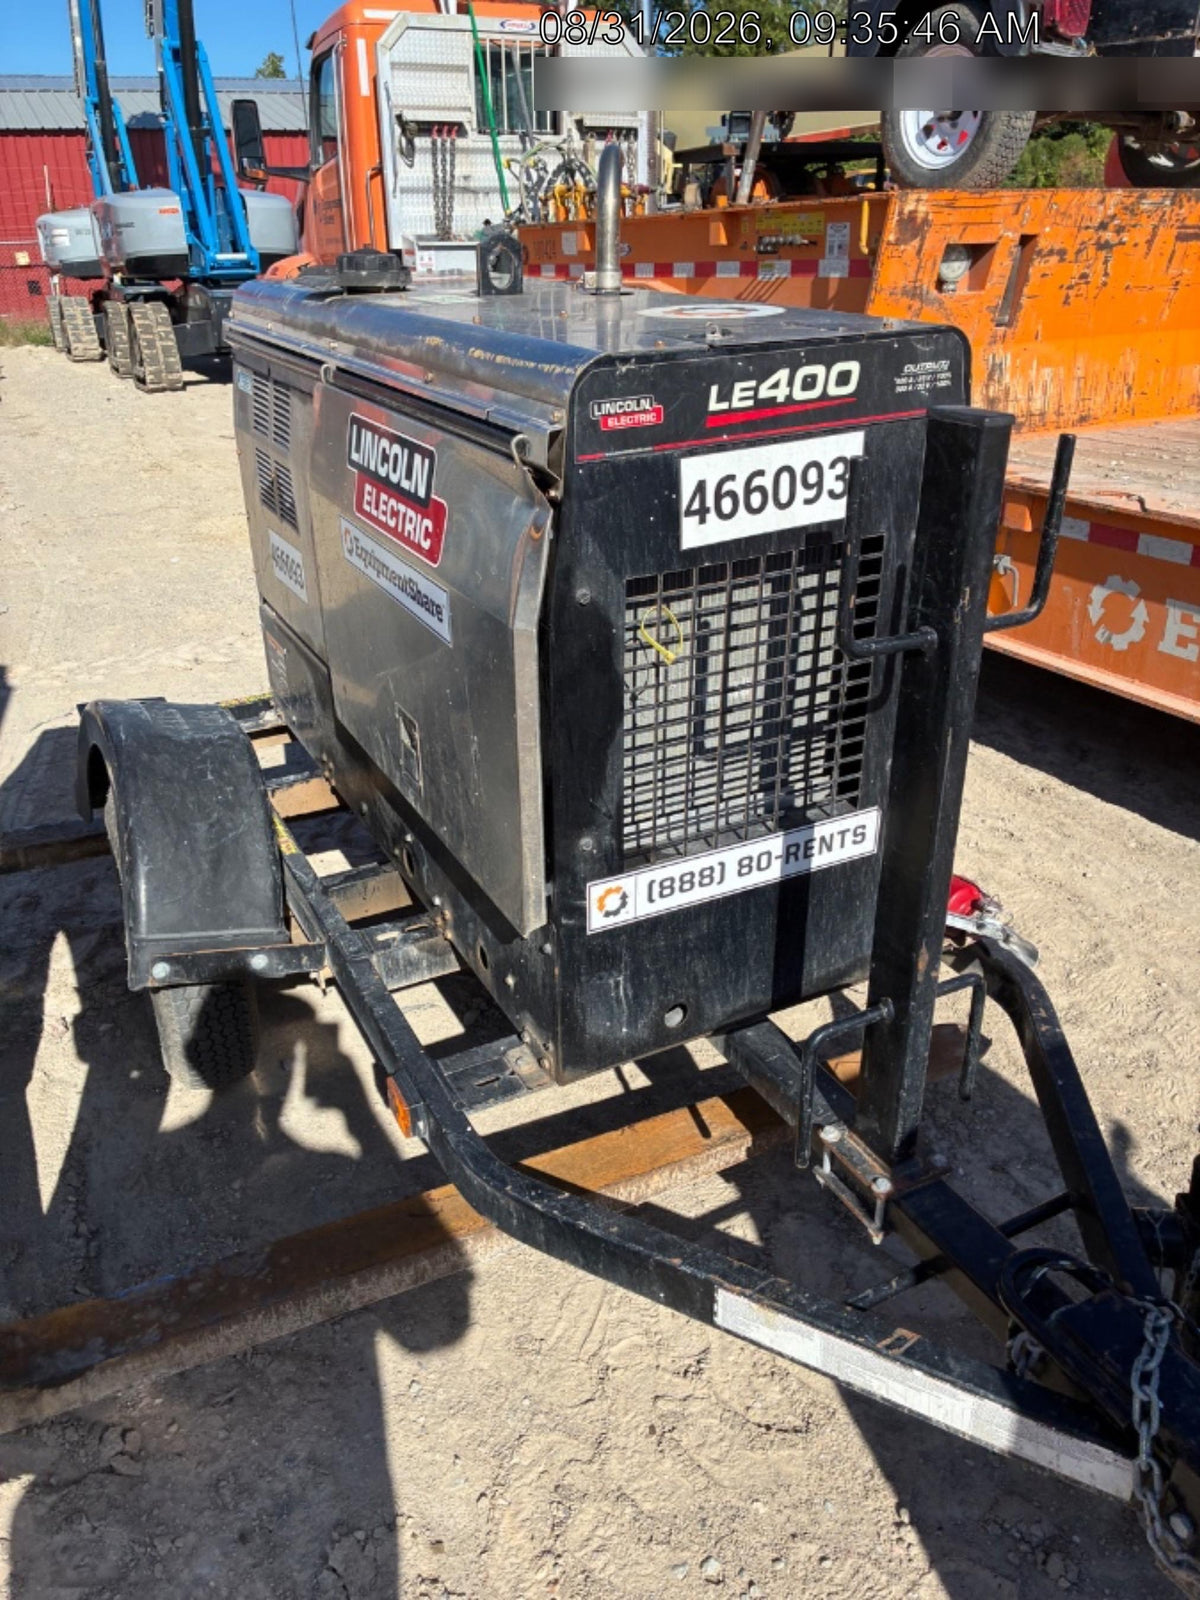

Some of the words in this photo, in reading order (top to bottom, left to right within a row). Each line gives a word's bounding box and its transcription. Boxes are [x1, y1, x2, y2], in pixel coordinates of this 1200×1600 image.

[593, 398, 653, 417] LINCOLN
[607, 412, 657, 428] ELECTRIC
[707, 360, 862, 412] LE400
[350, 424, 431, 499] LINCOLN
[682, 455, 849, 526] 466093
[362, 482, 434, 552] ELECTRIC
[353, 535, 444, 623] EquipmentShare
[646, 861, 726, 904] (888)
[736, 823, 868, 878] 80-RENTS
